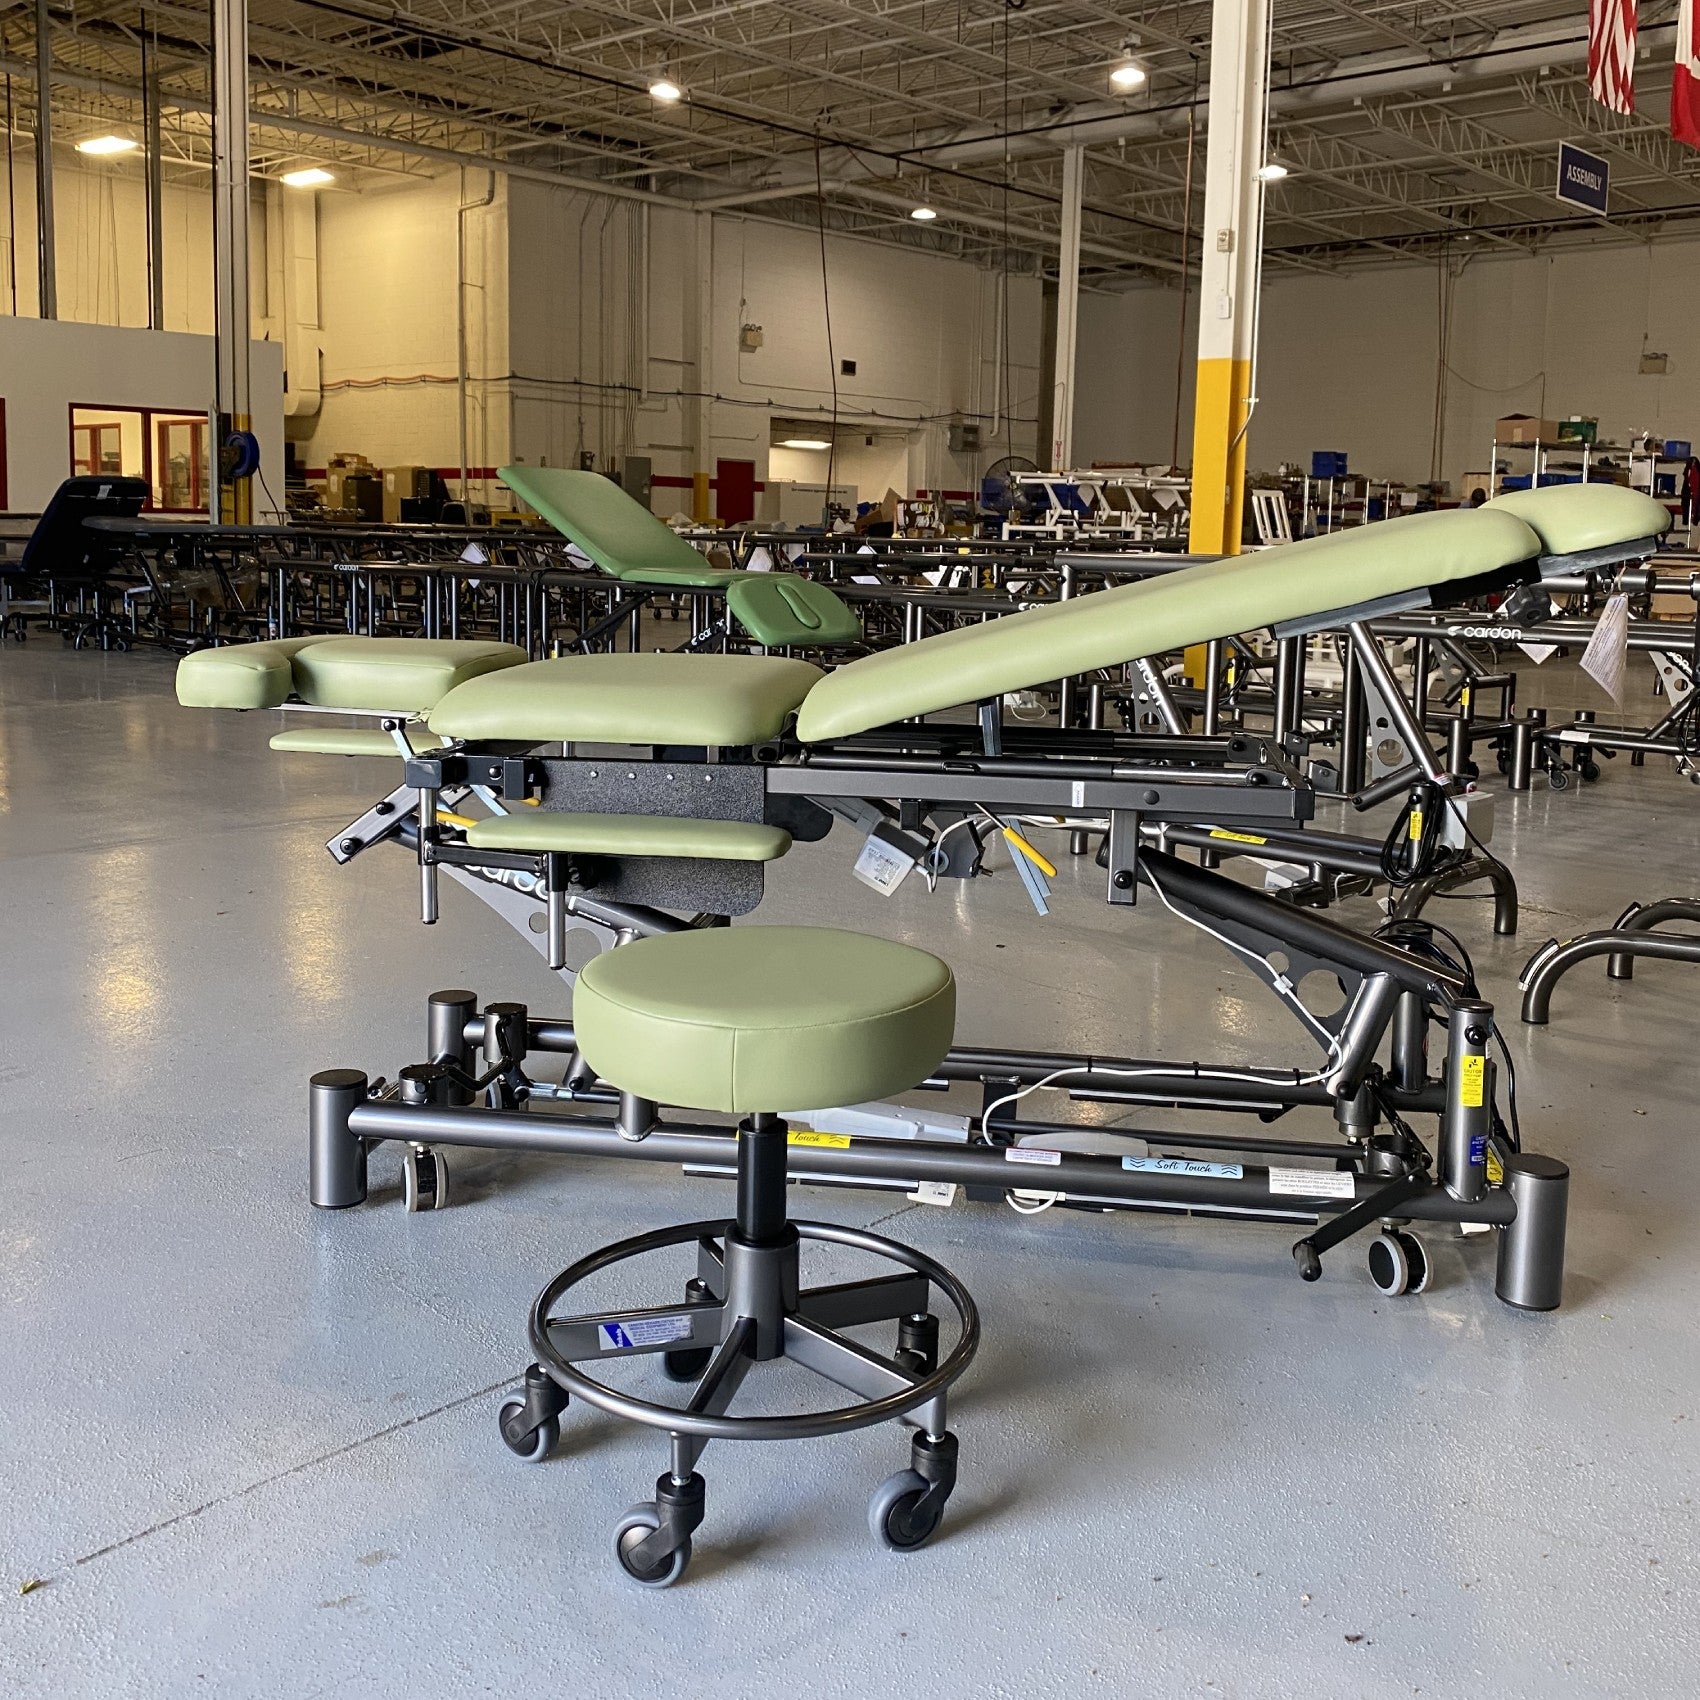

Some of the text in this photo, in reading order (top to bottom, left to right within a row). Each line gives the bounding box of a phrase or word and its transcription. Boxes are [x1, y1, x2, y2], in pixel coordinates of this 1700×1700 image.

[1566, 164, 1602, 191] ASSEMBLY
[1464, 625, 1521, 640] cardon
[794, 1132, 822, 1142] Touch
[1154, 1159, 1213, 1173] Soft Touch
